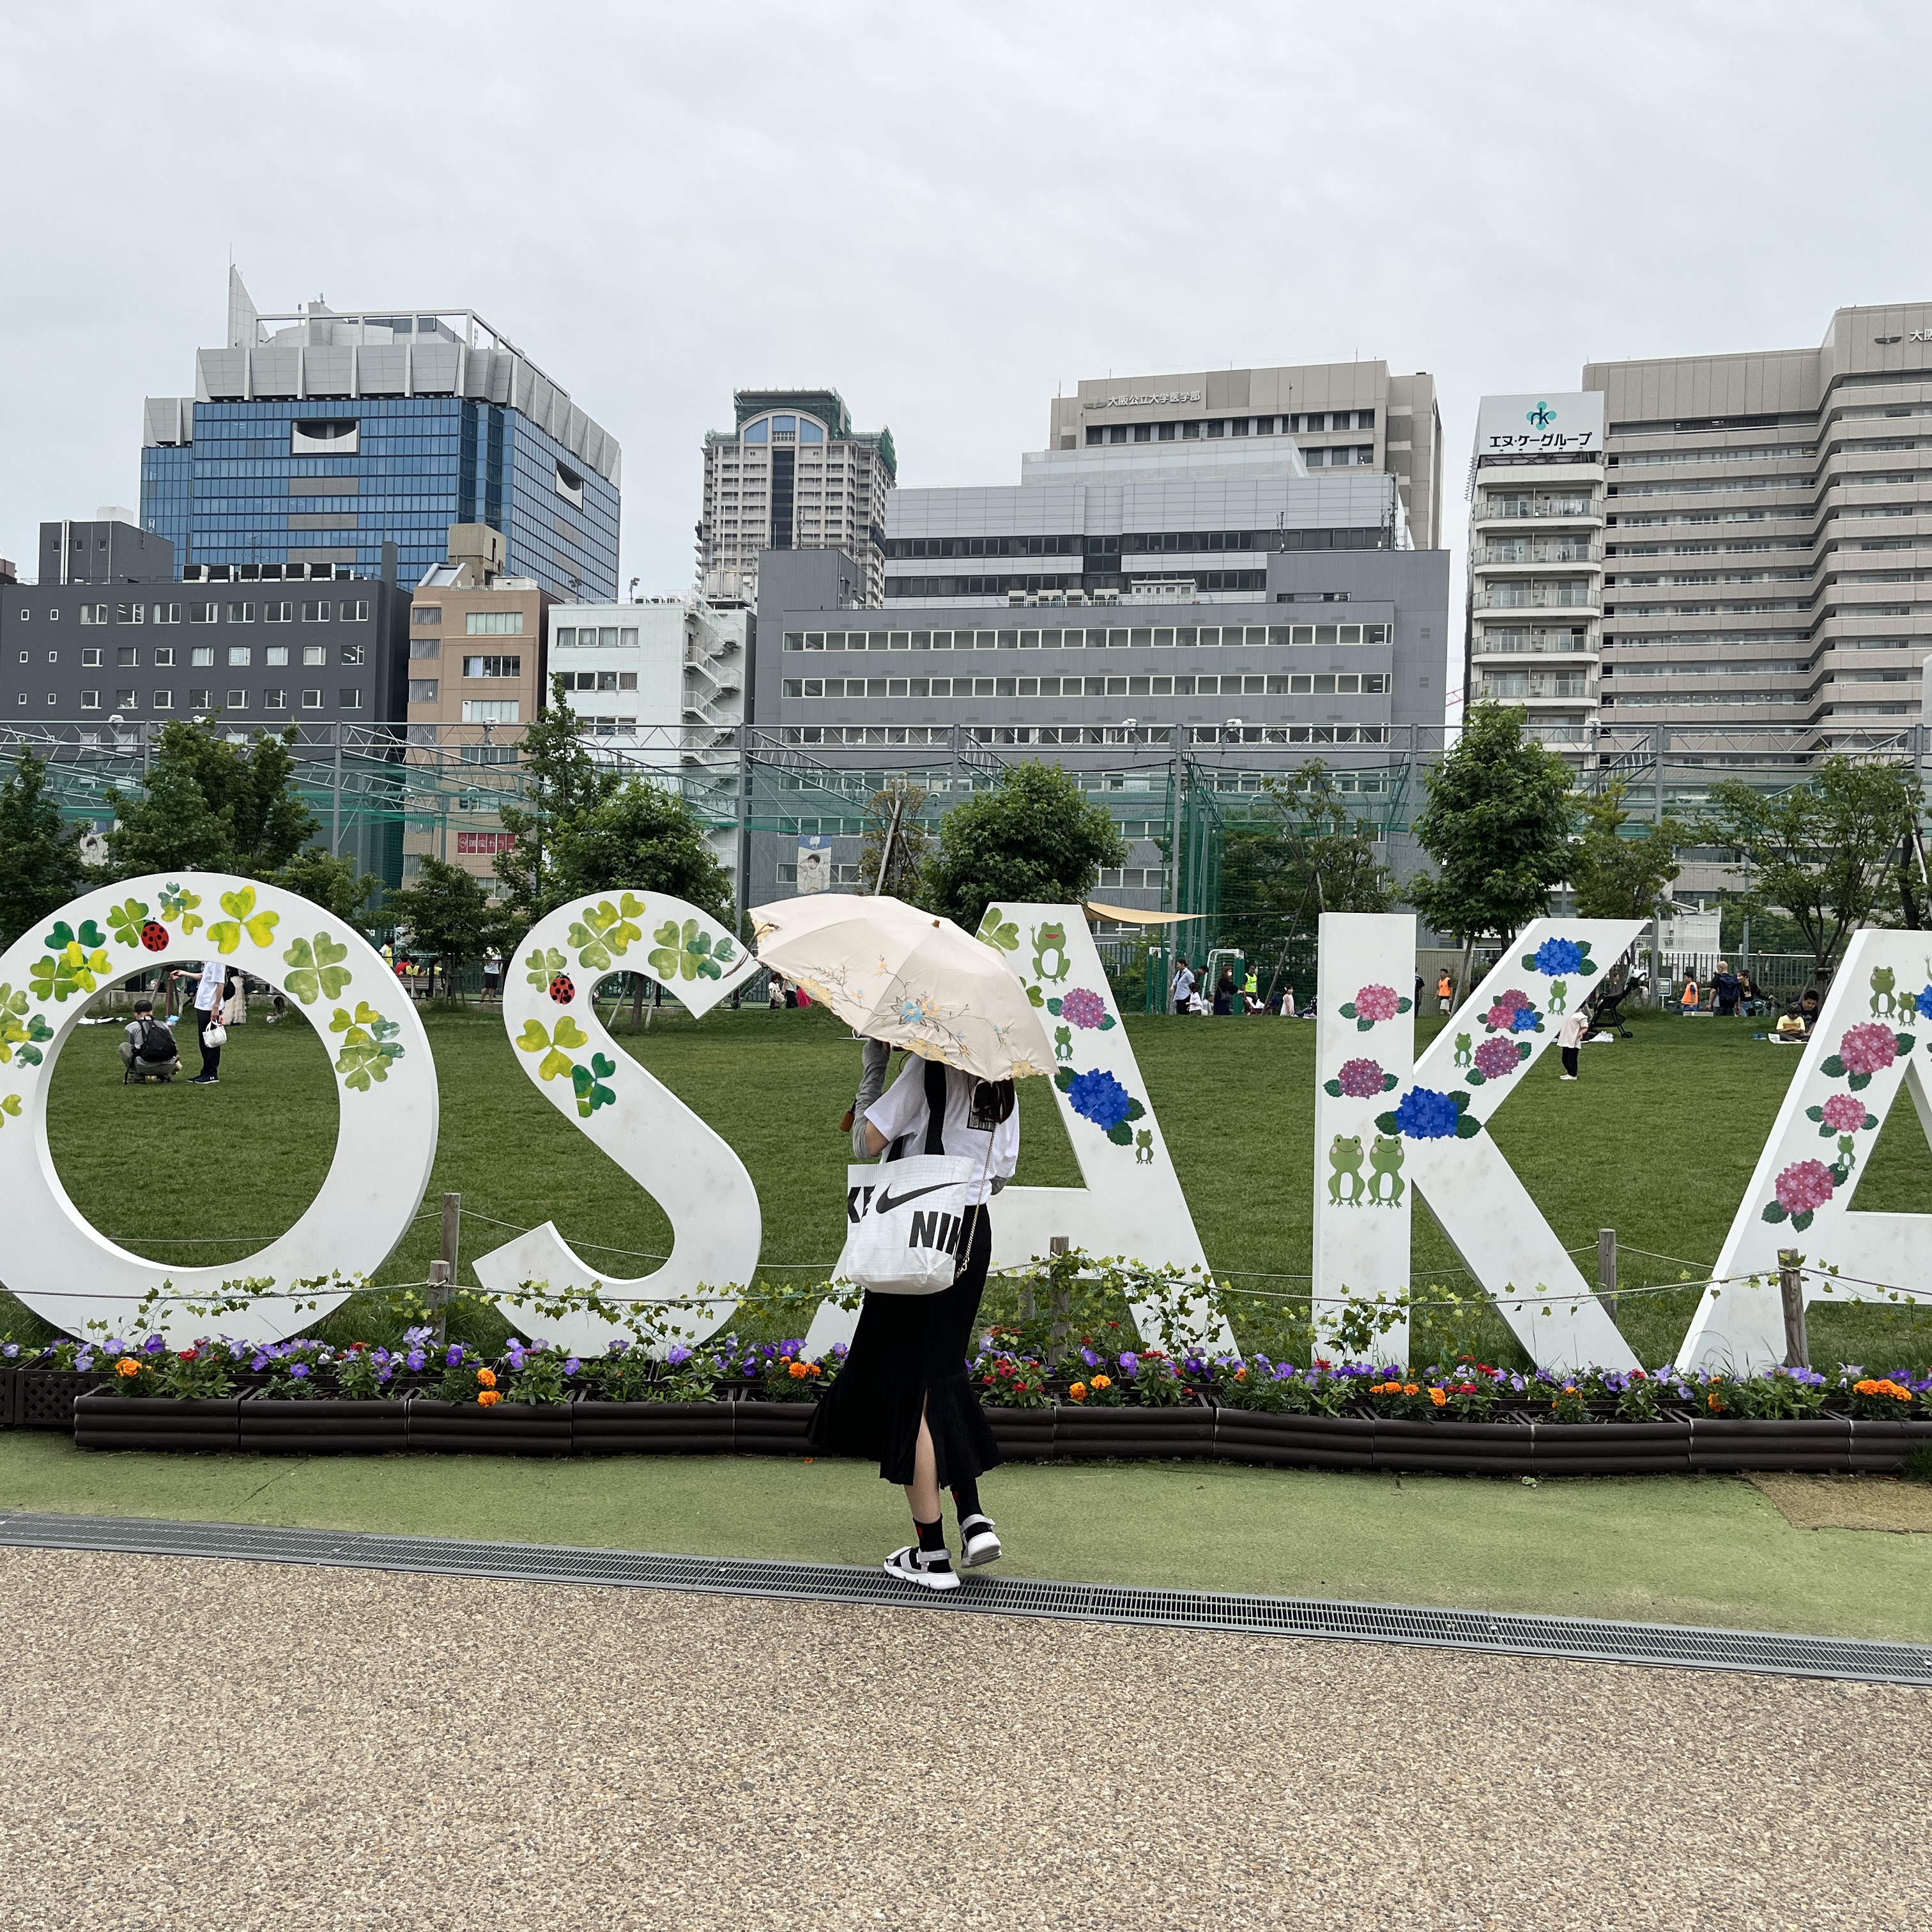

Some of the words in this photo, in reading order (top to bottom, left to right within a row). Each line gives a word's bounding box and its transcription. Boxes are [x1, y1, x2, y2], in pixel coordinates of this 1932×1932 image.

[1108, 390, 1201, 407] 大阪公立大学医学部
[1489, 431, 1593, 448] エヌ・ケーグループ
